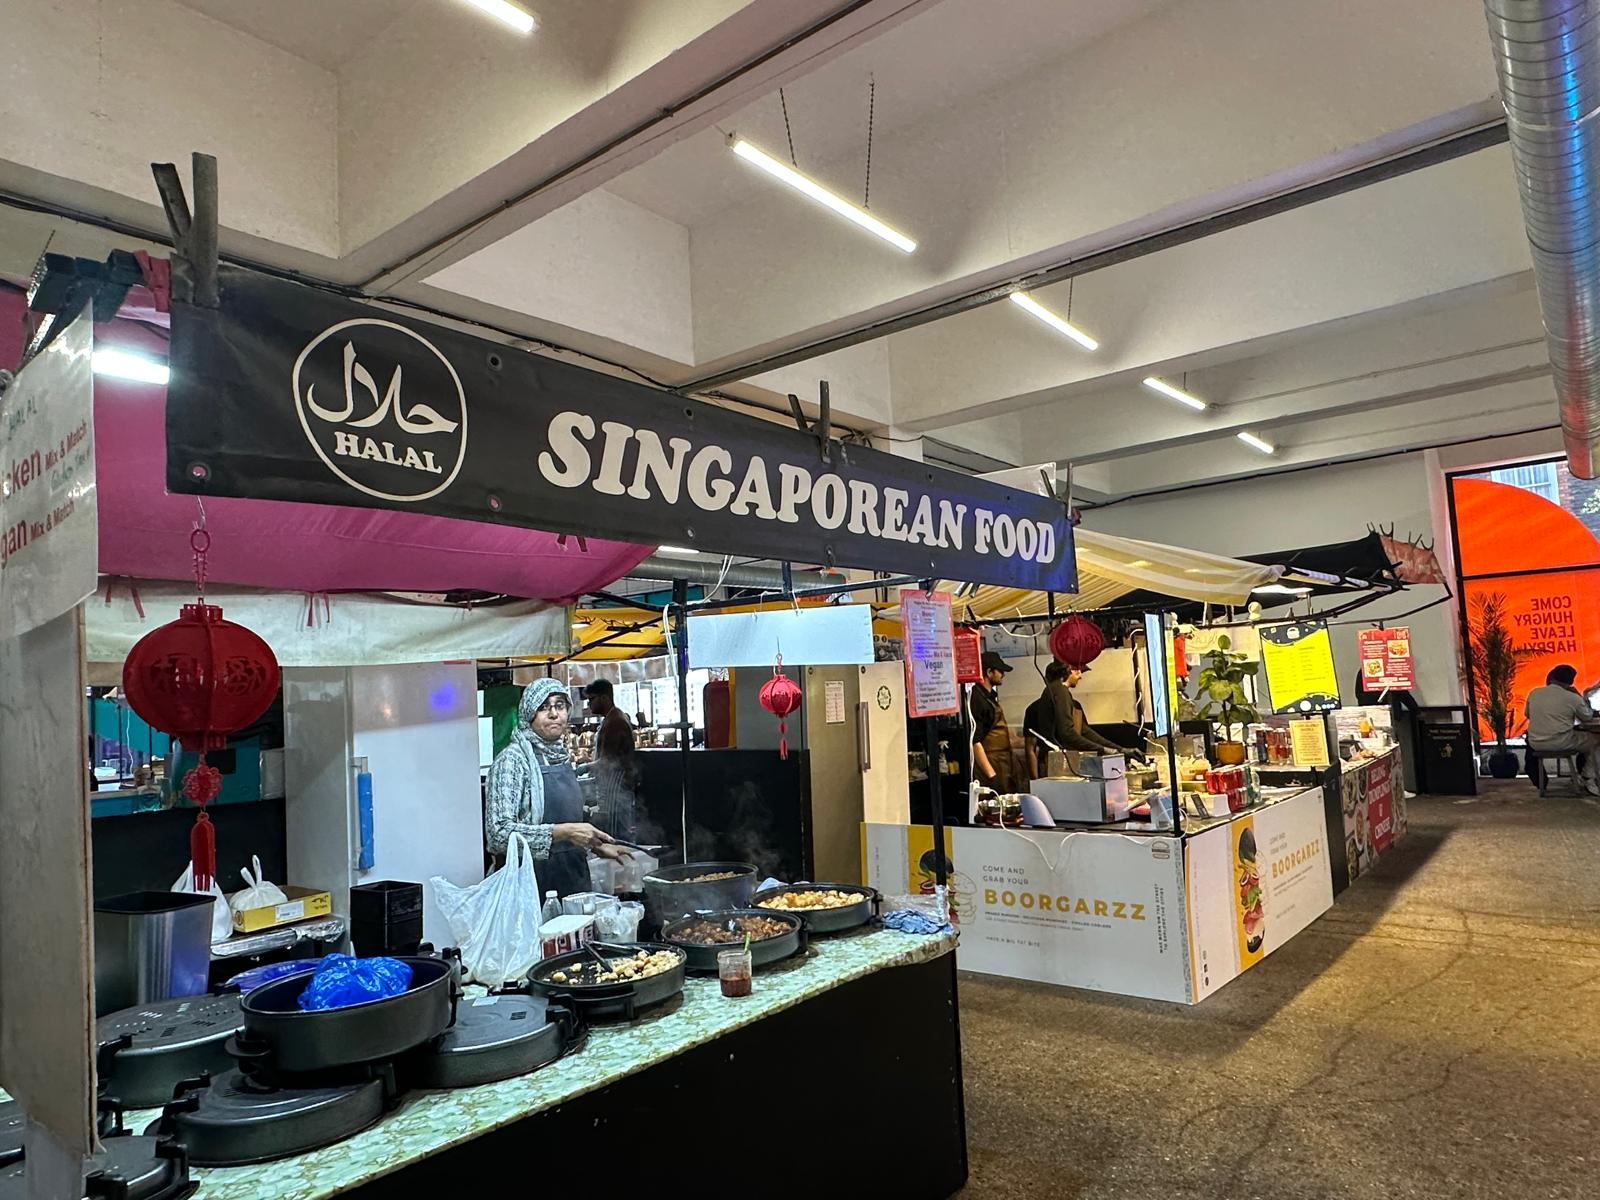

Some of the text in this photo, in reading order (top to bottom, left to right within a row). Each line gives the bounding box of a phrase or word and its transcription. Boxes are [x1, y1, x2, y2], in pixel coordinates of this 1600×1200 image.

[306, 340, 459, 434] حلال
[45, 453, 59, 471] Mix
[60, 441, 66, 460] &
[67, 418, 87, 453] Match
[334, 431, 443, 474] HALAL
[538, 411, 1056, 564] SINGAPOREAN FOOD
[31, 521, 45, 542] Mix
[46, 513, 52, 532] &
[53, 500, 74, 527] Match
[924, 659, 944, 671] Vegan
[982, 865, 1025, 875] COME AND
[1271, 838, 1320, 878] BOORGARZZ
[982, 875, 1029, 886] GRAB YOUR
[984, 888, 1146, 921] BOORGARZZ
